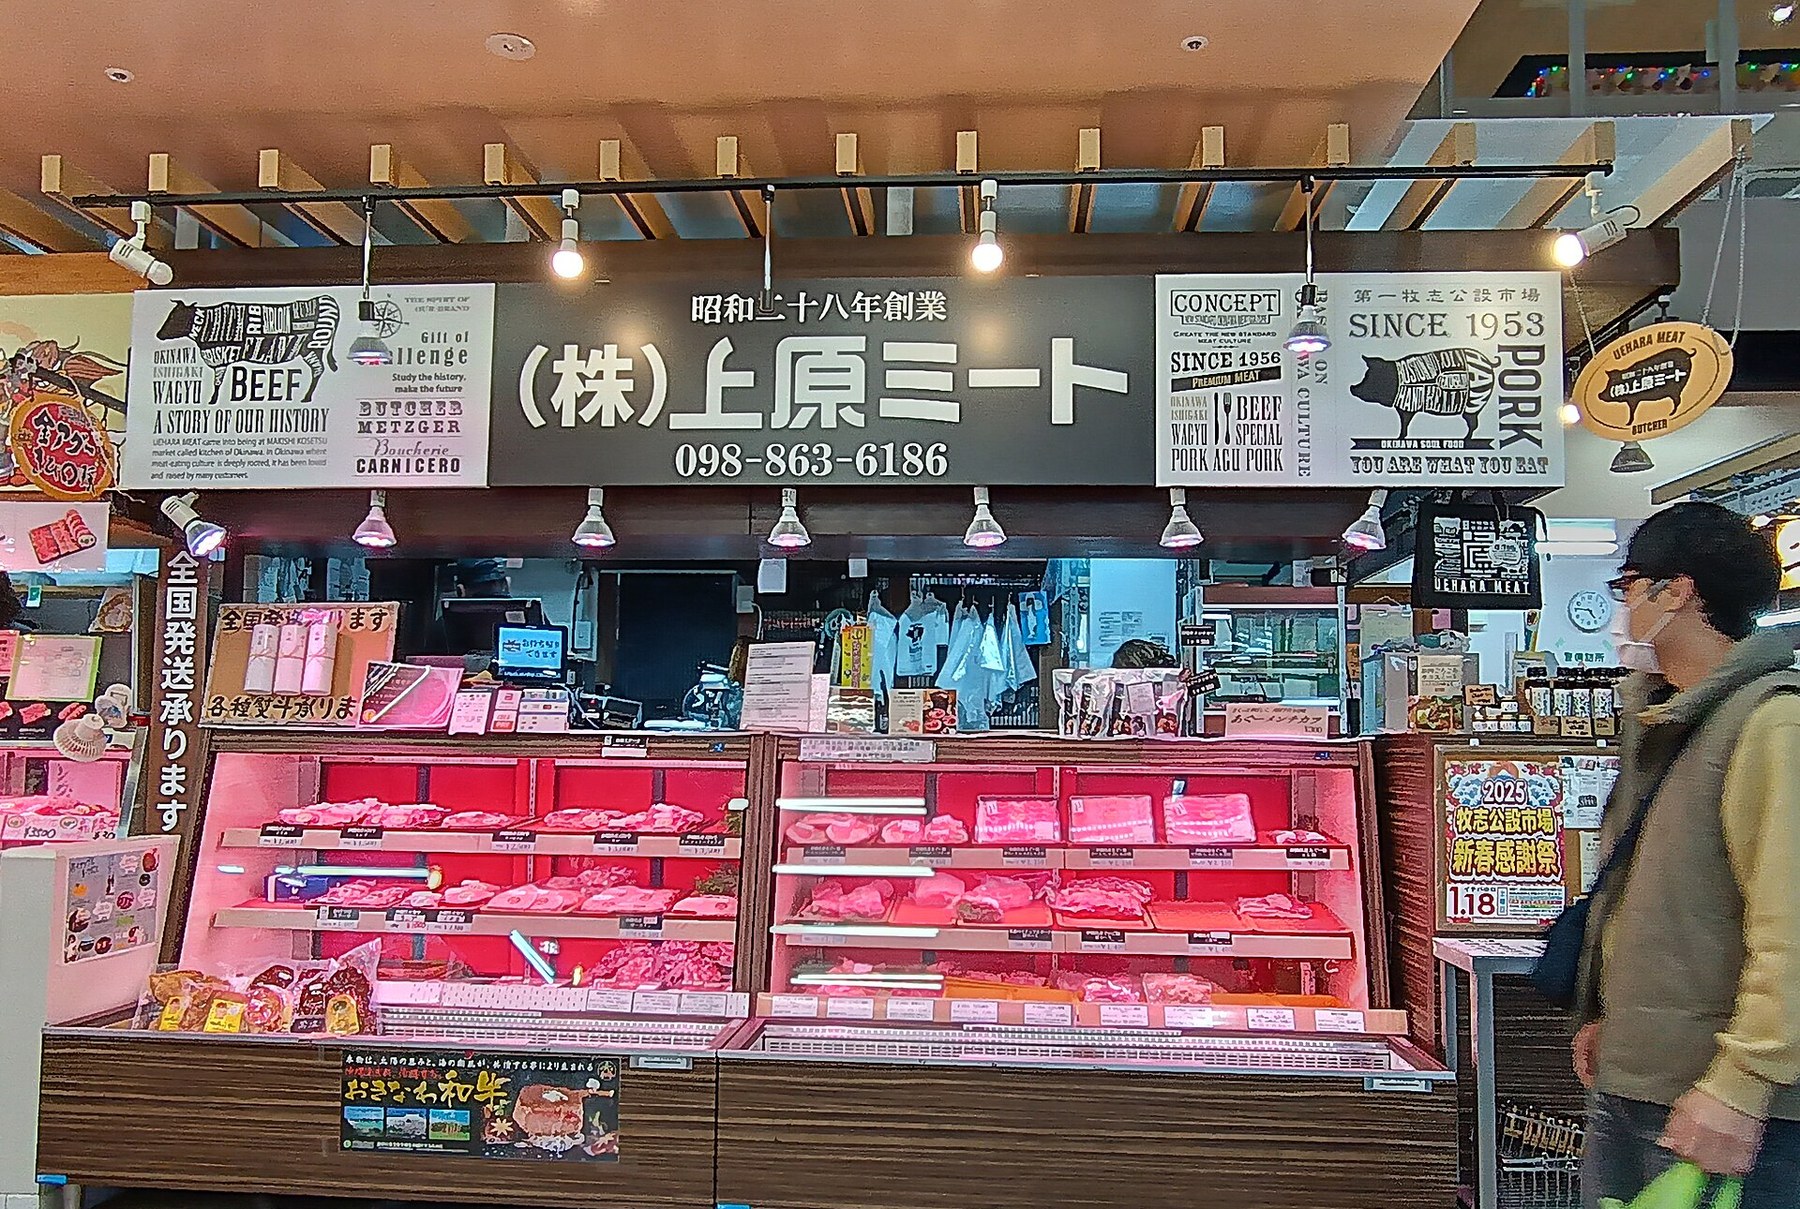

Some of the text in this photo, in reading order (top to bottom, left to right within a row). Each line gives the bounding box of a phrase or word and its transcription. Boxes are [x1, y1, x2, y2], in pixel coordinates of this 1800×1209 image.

[1174, 293, 1277, 312] CONCEPT
[1354, 288, 1541, 303] 第一牧志公設市場
[692, 292, 947, 324] 昭和二十八年創業
[246, 305, 262, 335] RIB
[307, 295, 339, 349] ROUND
[1349, 310, 1545, 341] SINCE 1953
[421, 331, 469, 344] Gift of
[1612, 331, 1686, 361] UEHARA MEAT
[153, 347, 197, 365] OKINAWA
[388, 347, 468, 367] llenge
[1171, 351, 1282, 373] SINCE 1956
[230, 366, 303, 402] BEEF
[392, 373, 417, 383] Study
[418, 373, 433, 381] the
[395, 384, 463, 393] make the future
[519, 335, 1128, 429] (株)上原ミート
[1192, 370, 1261, 389] PREMIUM MEAT
[153, 381, 201, 405] WAGYU
[1171, 396, 1207, 408] OKINAWA
[1497, 343, 1546, 450] PORK
[359, 400, 463, 416] BUTCHER
[1171, 409, 1208, 421] ISHIGAKI
[1236, 395, 1282, 421] BEEF
[153, 408, 329, 434] A STORY OF OUR HISTORY
[357, 420, 461, 434] METZGER
[1297, 387, 1311, 477] CULTURE
[1631, 419, 1668, 436] BUTCHER
[152, 438, 180, 446] UEHARA
[182, 438, 201, 446] MEAT
[237, 438, 256, 447] being
[1171, 423, 1208, 446] WAGYU
[1236, 423, 1283, 446] SPECIAL
[1381, 439, 1464, 449] OKINAWA SOUL FOOD
[177, 448, 197, 456] called
[225, 448, 232, 456] of
[373, 438, 449, 456] Boucherie
[192, 459, 215, 467] culture
[223, 459, 246, 468] deeply
[356, 458, 460, 474] CARNICERO
[676, 441, 948, 479] 098-863-6186
[1171, 448, 1284, 472] PORK AGU PORK
[1350, 456, 1549, 474] YOU ARE WHAT YOU EAT
[186, 472, 194, 481] by
[195, 472, 214, 480] many
[1434, 577, 1530, 594] UEHARA MEAT
[222, 609, 388, 632] 全国発送ります
[156, 550, 200, 832] 全国発送承ります
[207, 694, 358, 719] 各種熨斗承りま
[1482, 780, 1527, 804] 2025
[1456, 807, 1555, 835] 牧志公設市場
[1451, 837, 1558, 875] 新春感謝祭
[1449, 886, 1496, 916] 1.18
[344, 1069, 512, 1108] おきなわ和牛
